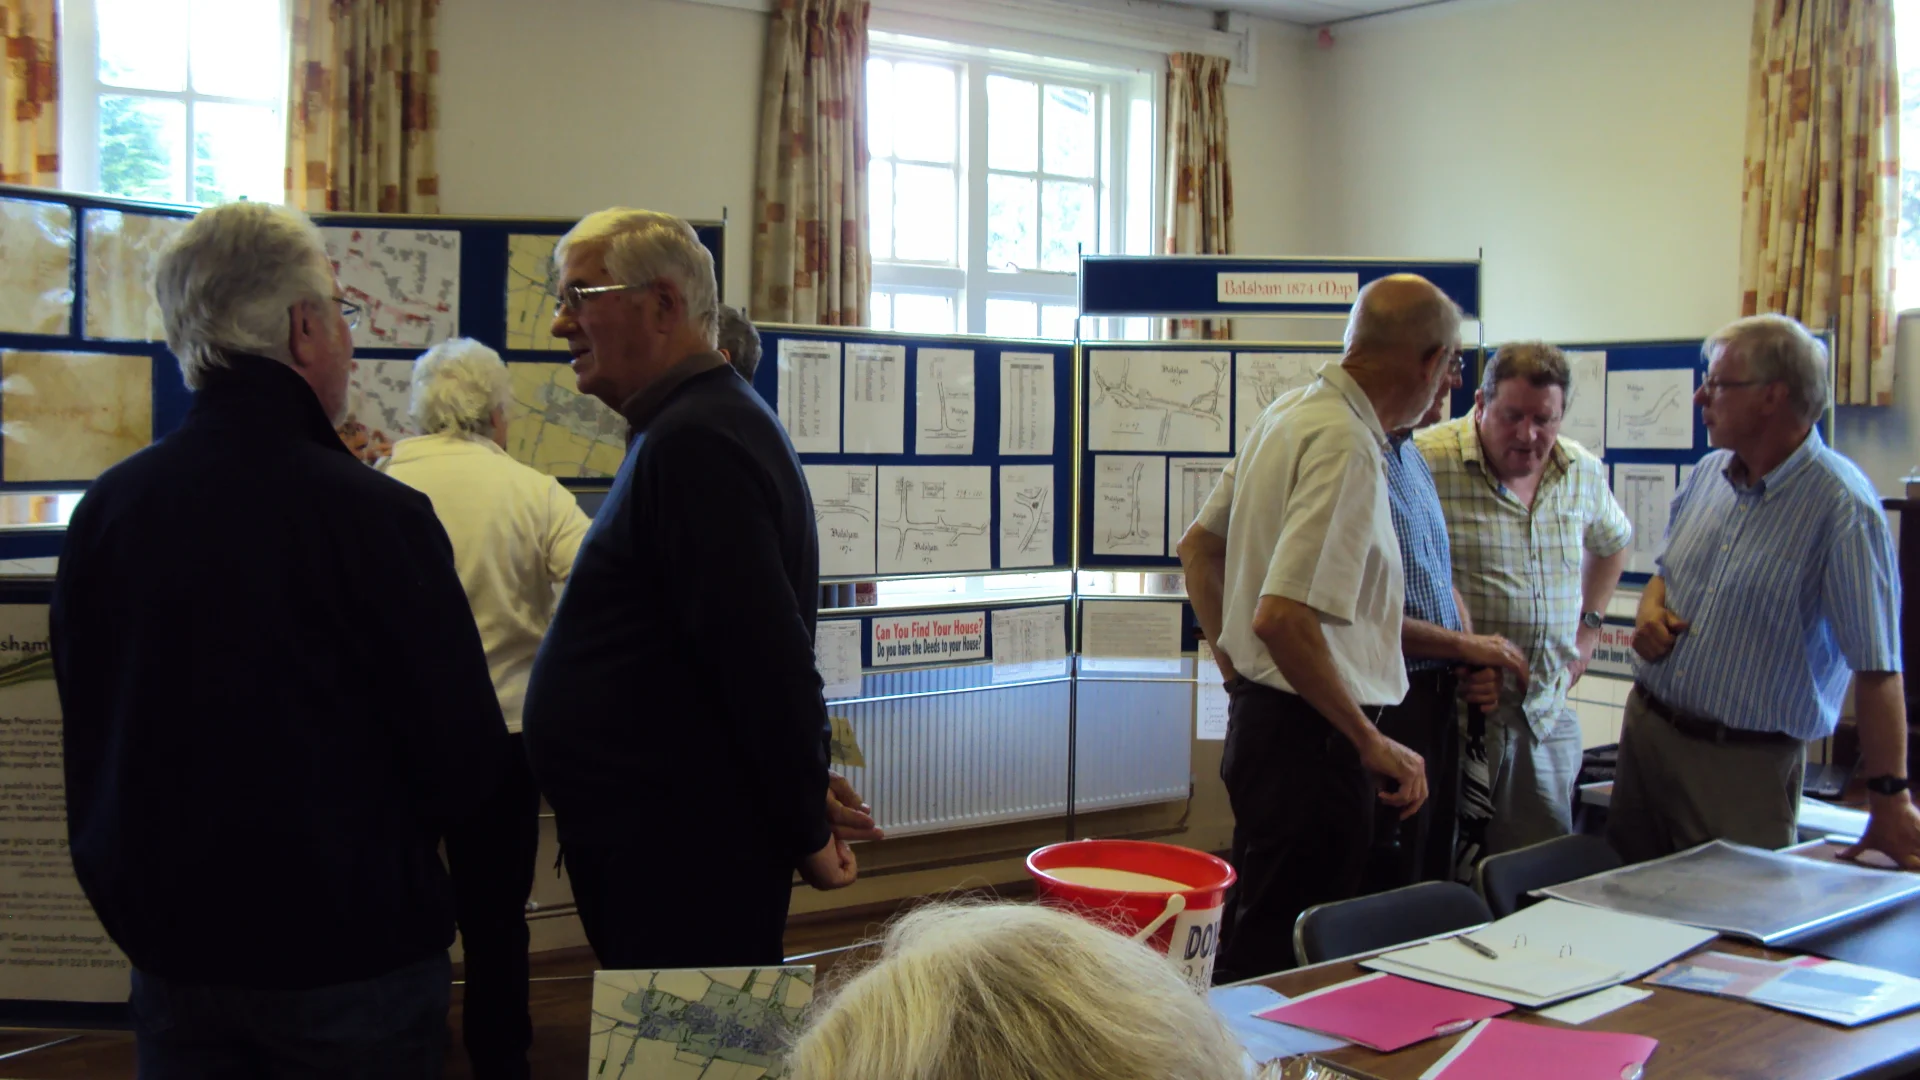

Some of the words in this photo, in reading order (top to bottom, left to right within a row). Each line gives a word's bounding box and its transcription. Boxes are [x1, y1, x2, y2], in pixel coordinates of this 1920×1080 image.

[1224, 280, 1282, 296] Balsham
[1287, 282, 1314, 296] 1874
[1318, 280, 1352, 300] Map
[876, 624, 890, 640] Can
[894, 623, 908, 639] You
[912, 620, 930, 638] Find
[932, 620, 952, 636] Your
[954, 617, 984, 635] House?
[877, 642, 884, 658] Do
[886, 645, 896, 662] you
[898, 640, 911, 656] have
[912, 639, 922, 656] the
[924, 638, 940, 654] Deeds
[942, 639, 948, 653] to
[948, 639, 961, 657] your
[962, 634, 982, 651] House?
